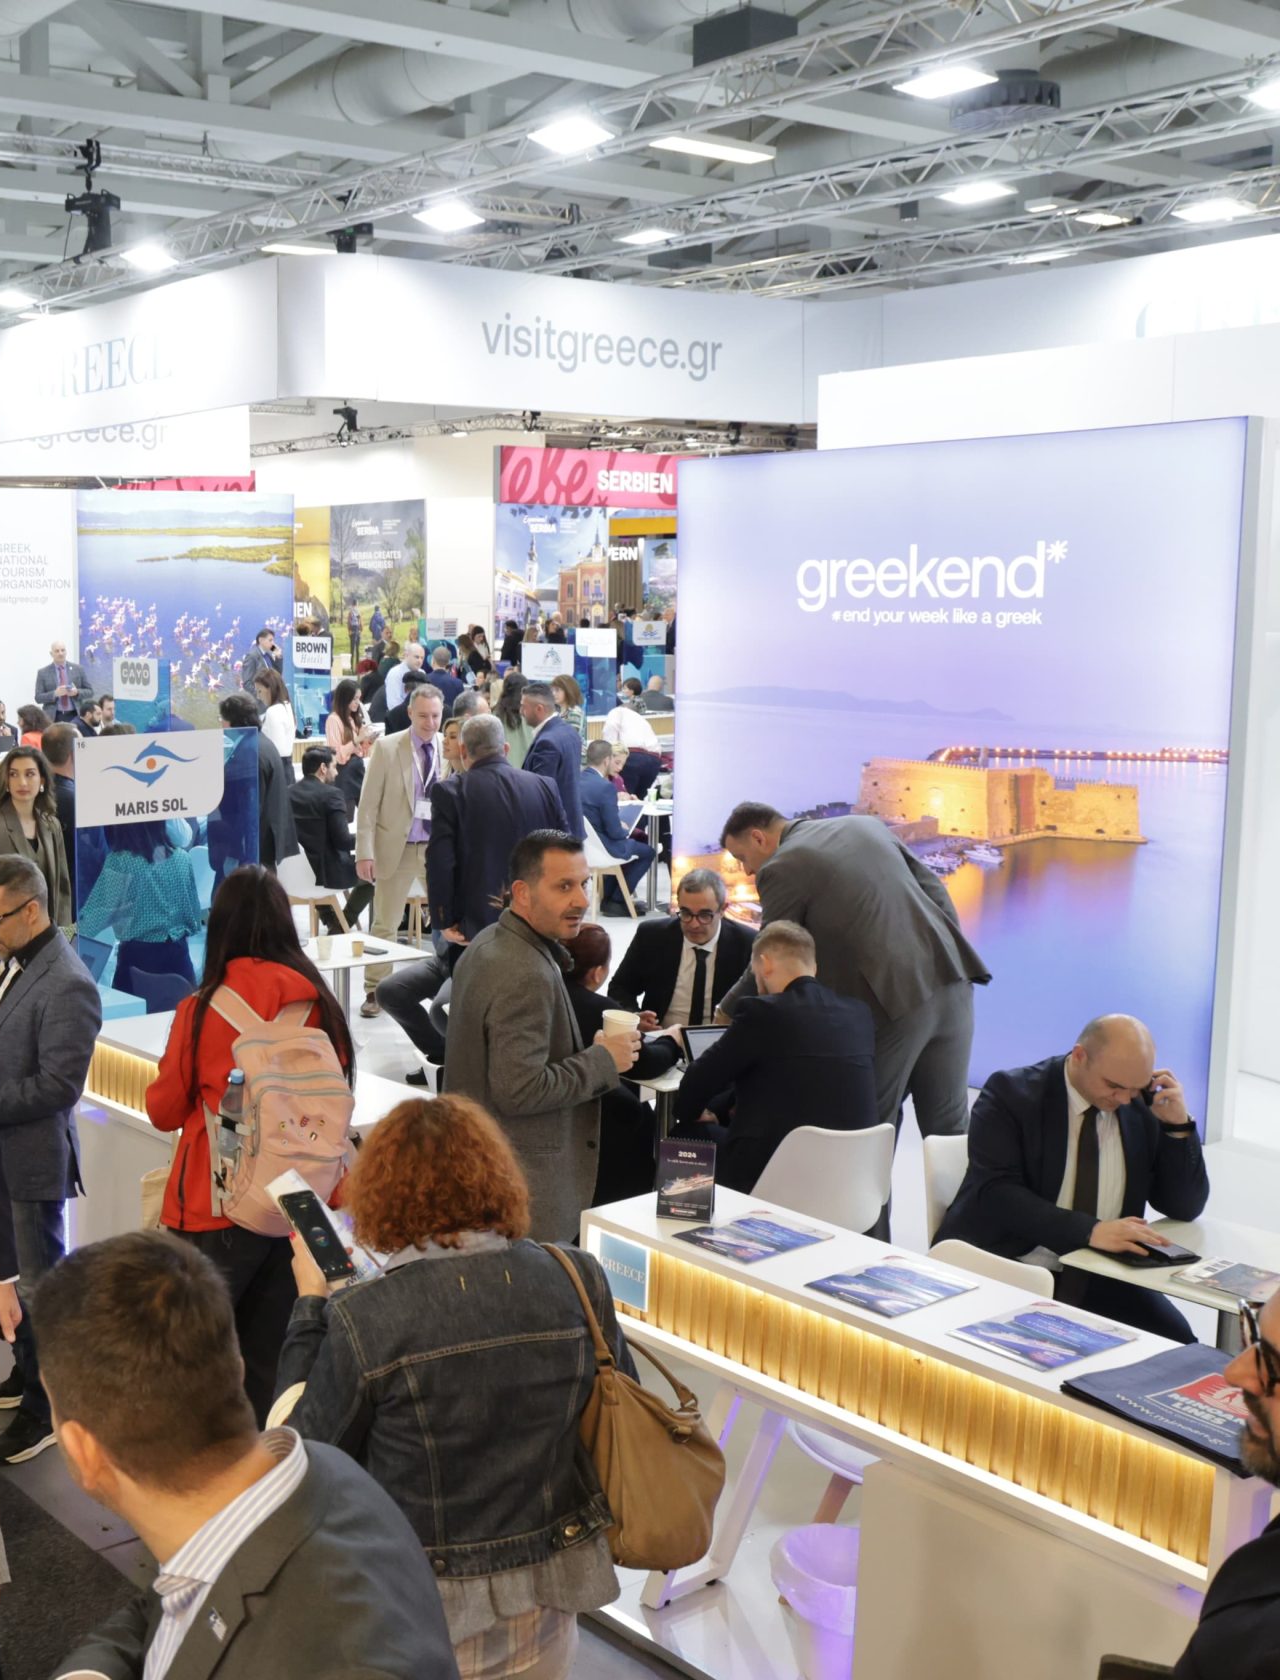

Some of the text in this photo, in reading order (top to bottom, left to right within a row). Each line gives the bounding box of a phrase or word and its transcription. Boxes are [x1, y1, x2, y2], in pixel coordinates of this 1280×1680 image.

[481, 312, 723, 382] visitgreece.gr
[597, 469, 673, 495] SERBIEN
[873, 609, 905, 626] your
[908, 608, 949, 623] week
[952, 608, 977, 624] like
[981, 611, 992, 624] a
[996, 608, 1042, 628] greek
[295, 642, 328, 653] BROWN
[300, 655, 323, 665] Hotels
[115, 798, 188, 817] MARIS SOL
[678, 1150, 697, 1159] 2024
[600, 1256, 646, 1285] GREECE
[1171, 1402, 1227, 1425] LINES
